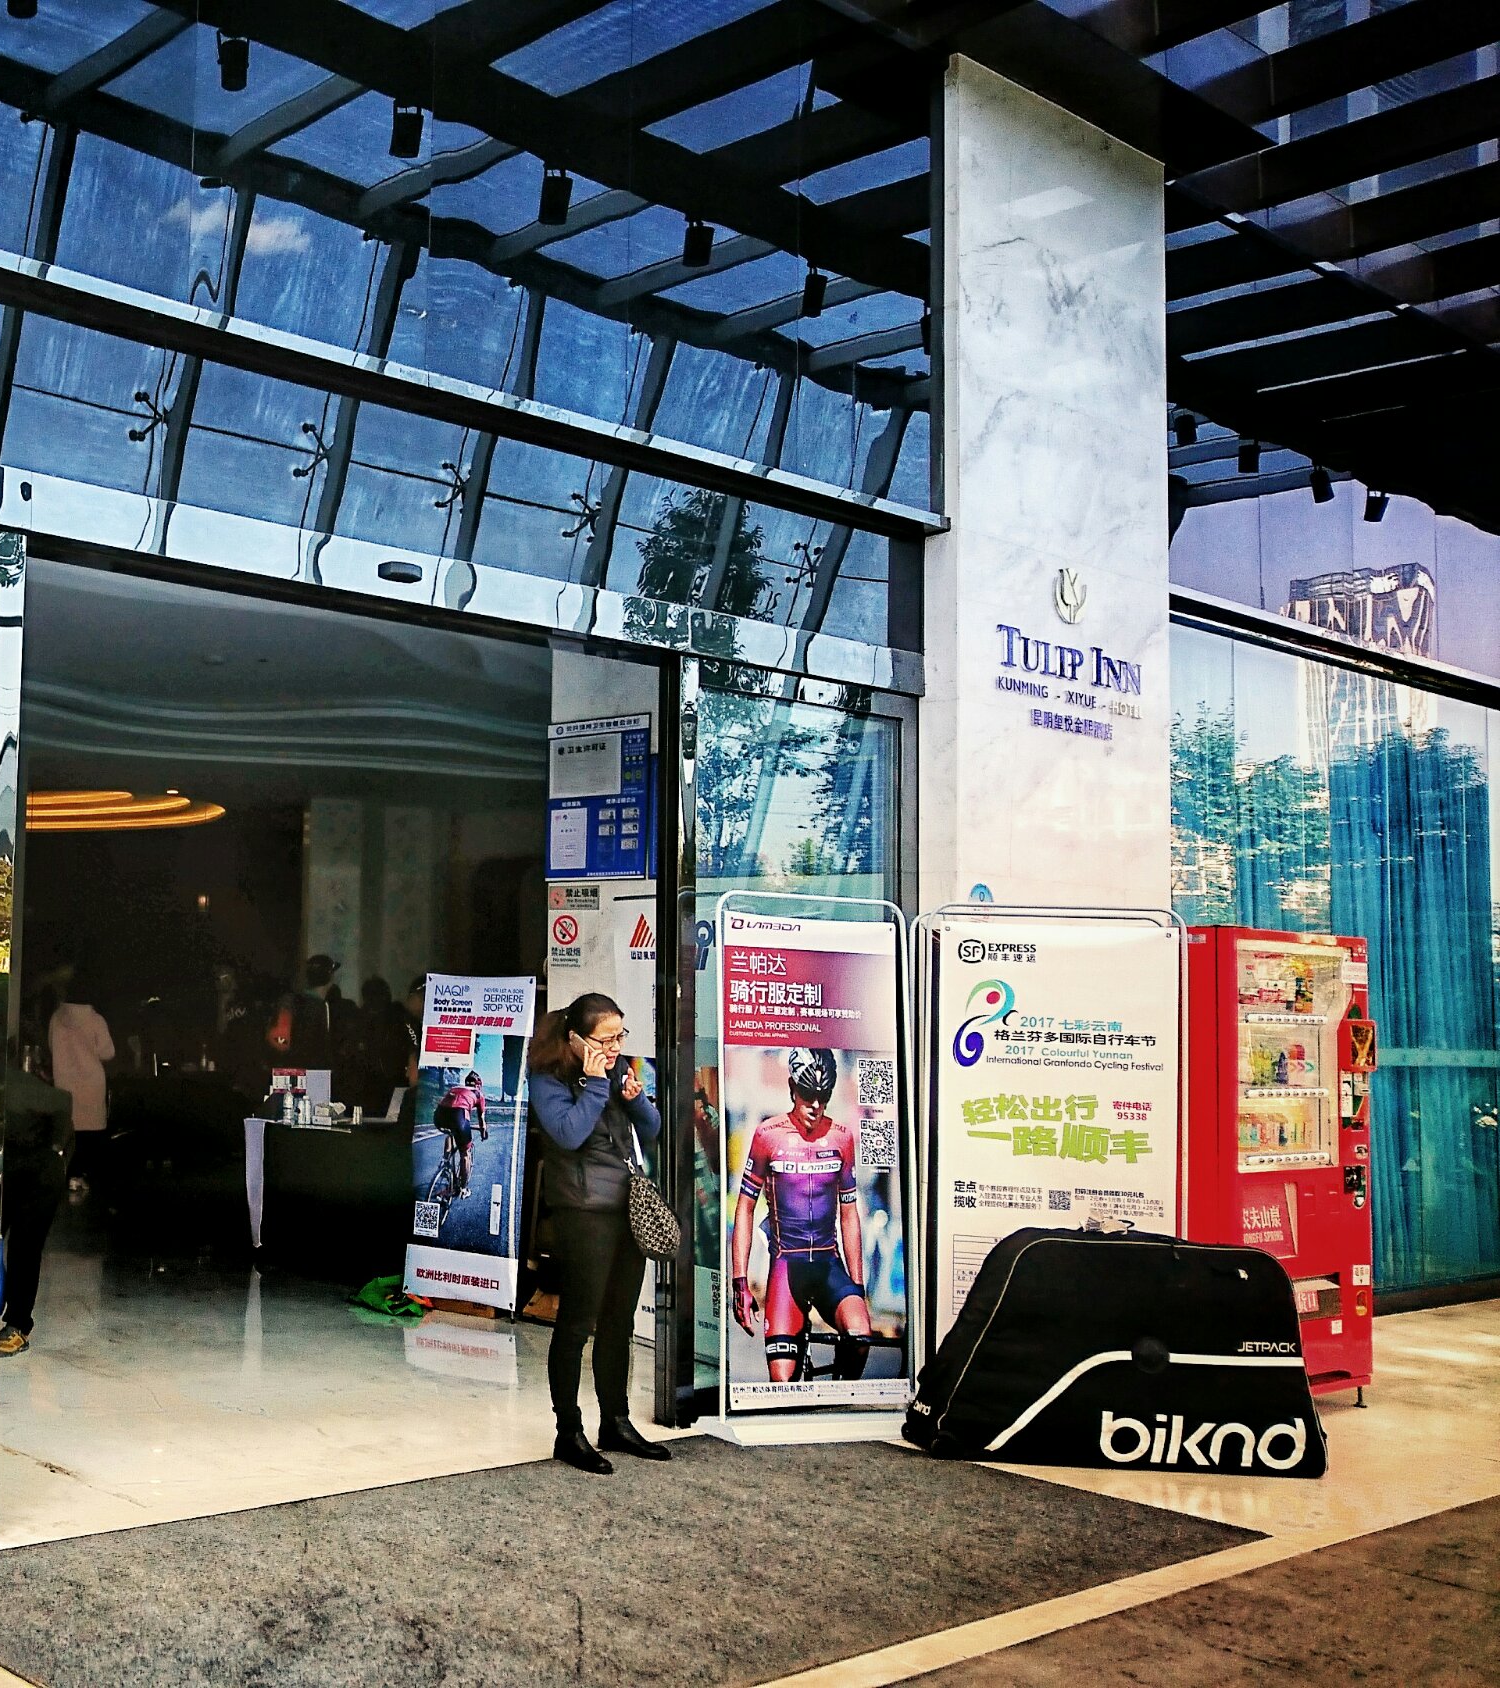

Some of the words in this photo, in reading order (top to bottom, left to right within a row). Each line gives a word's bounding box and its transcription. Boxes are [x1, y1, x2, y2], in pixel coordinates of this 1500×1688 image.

[996, 623, 1084, 681] TULIP
[1090, 646, 1142, 696] INN
[997, 675, 1049, 699] KUNMING
[1067, 690, 1097, 709] XIYUE
[565, 888, 598, 898] 禁止吸烟
[988, 943, 1037, 953] EXPRESS
[730, 951, 787, 976] 兰帕达
[987, 953, 1037, 963] 顺丰速运
[484, 994, 524, 1003] DERRIERE
[729, 979, 822, 1006] 骑行服定制
[433, 998, 449, 1006] Body
[483, 1003, 503, 1012] STOP
[505, 1004, 524, 1013] YOU
[729, 1020, 763, 1029] LAMEDA
[765, 1021, 822, 1033] PROFESSIONAL
[1020, 1016, 1055, 1028] 2017
[1058, 1019, 1123, 1032] 七彩云南
[994, 1029, 1157, 1047] 格兰芬多国际自行车节
[1005, 1045, 1035, 1056] 2017
[1041, 1048, 1090, 1058] Colourful
[1092, 1050, 1134, 1060] Yunnan
[986, 1055, 1042, 1066] International
[1043, 1058, 1092, 1068] Granfondo
[1094, 1060, 1129, 1072] Cycling
[1131, 1062, 1164, 1072] Festival
[960, 1093, 1099, 1125] 轻松出行
[1112, 1100, 1153, 1112] 寄件电话
[1116, 1111, 1148, 1121] 95338
[966, 1122, 1153, 1164] 一路顺丰
[954, 1180, 977, 1193] 定点
[954, 1195, 977, 1208] 揽收
[1264, 1230, 1284, 1242] SPRING
[416, 1267, 500, 1291] 欧洲比利时原装进口
[1237, 1340, 1297, 1354] JETPACK
[1100, 1410, 1307, 1470] biknd
